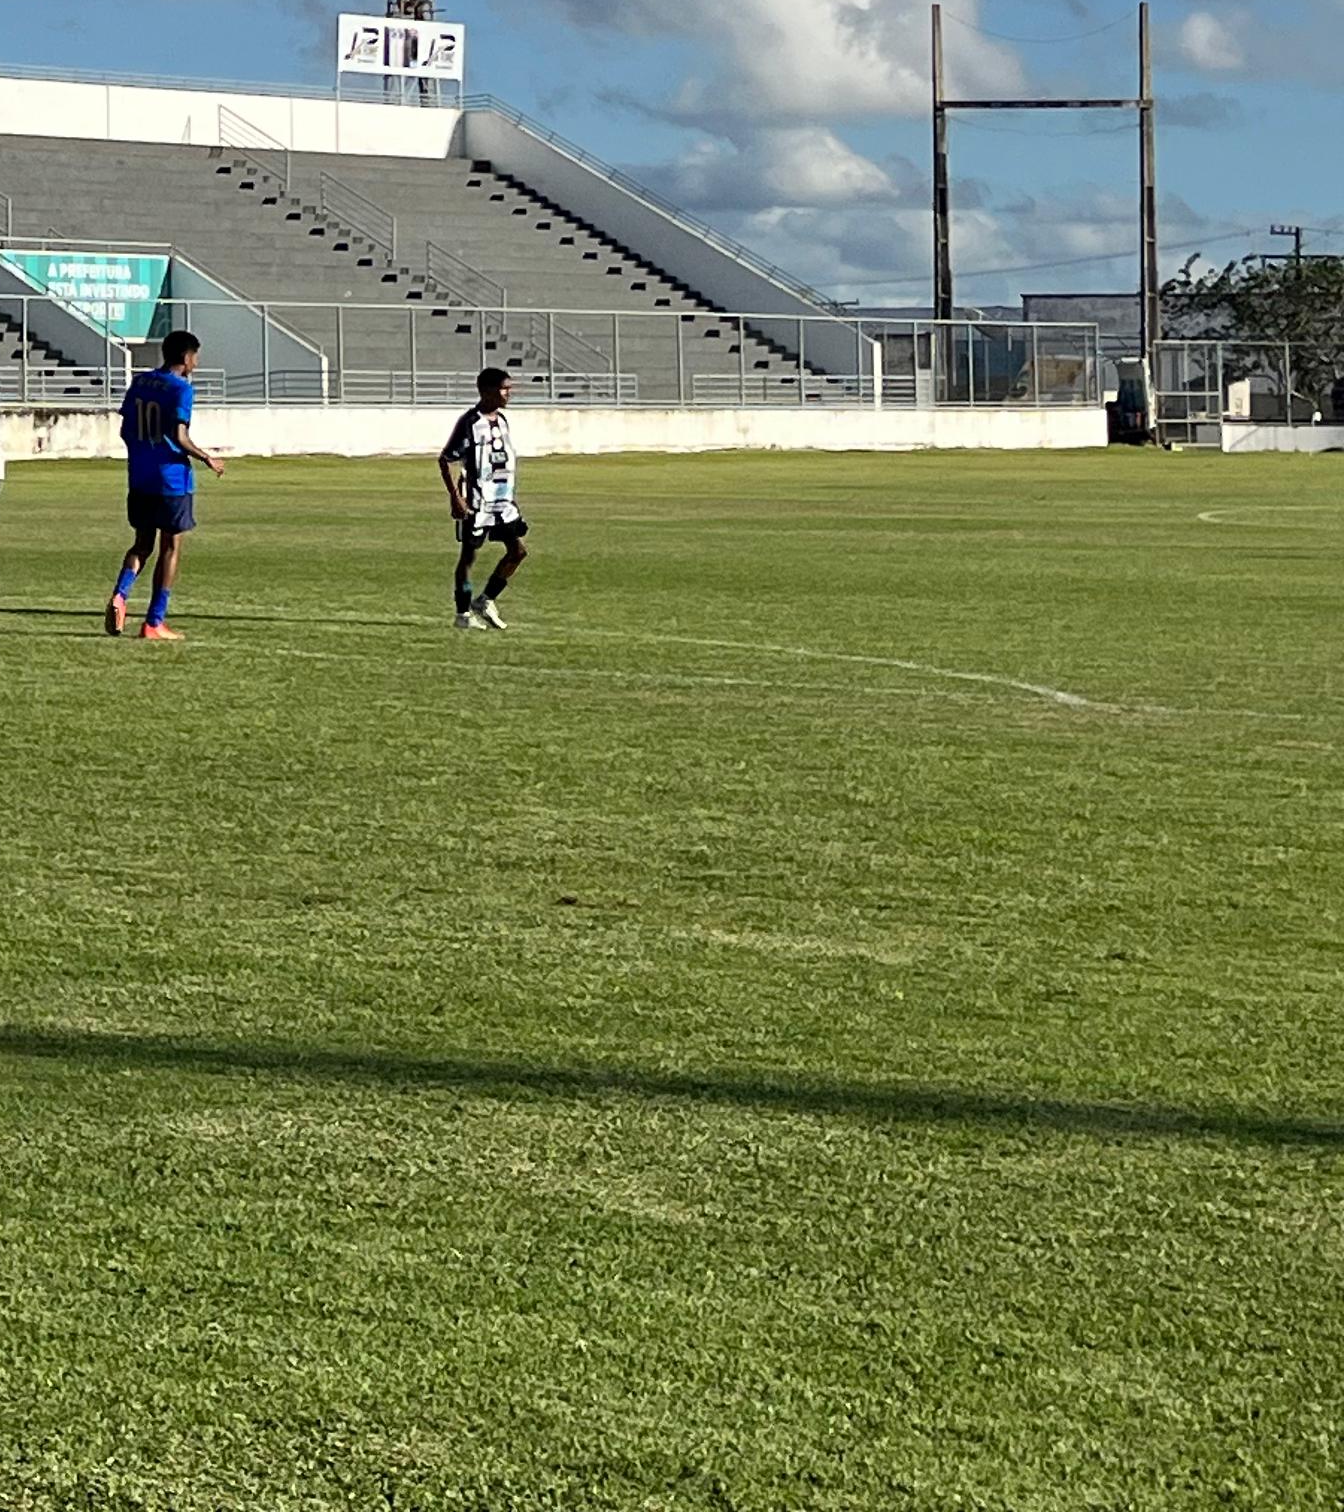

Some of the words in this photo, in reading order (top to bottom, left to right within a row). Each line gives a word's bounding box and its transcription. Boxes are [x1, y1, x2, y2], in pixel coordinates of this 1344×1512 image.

[47, 263, 57, 278] A
[59, 263, 131, 280] PREFEITURA
[135, 398, 162, 444] 10
